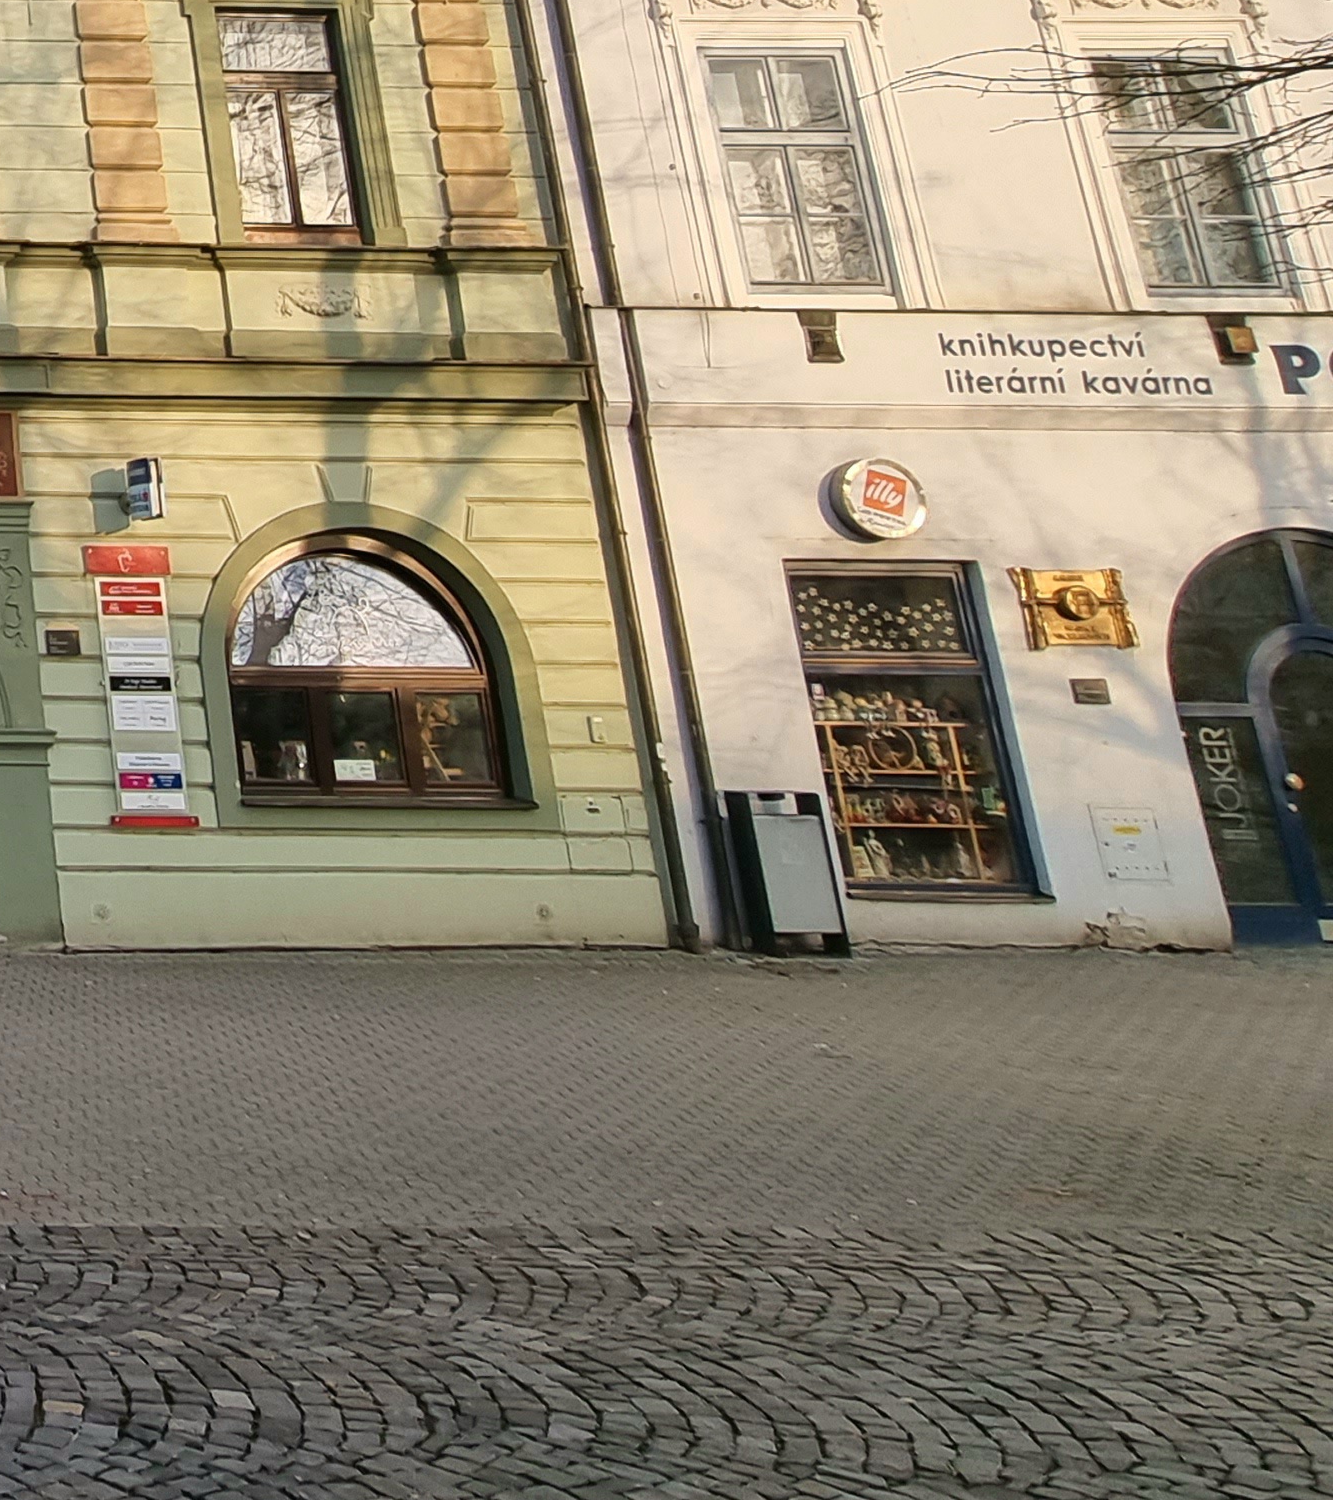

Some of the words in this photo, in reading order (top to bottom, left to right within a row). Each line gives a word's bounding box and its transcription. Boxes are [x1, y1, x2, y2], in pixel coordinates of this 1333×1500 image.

[938, 331, 1146, 362] knihkupectví
[944, 367, 1067, 395] literární
[1081, 367, 1214, 396] kavárna
[1269, 344, 1333, 396] P
[865, 478, 903, 509] illy
[1199, 726, 1247, 828] JOKER
